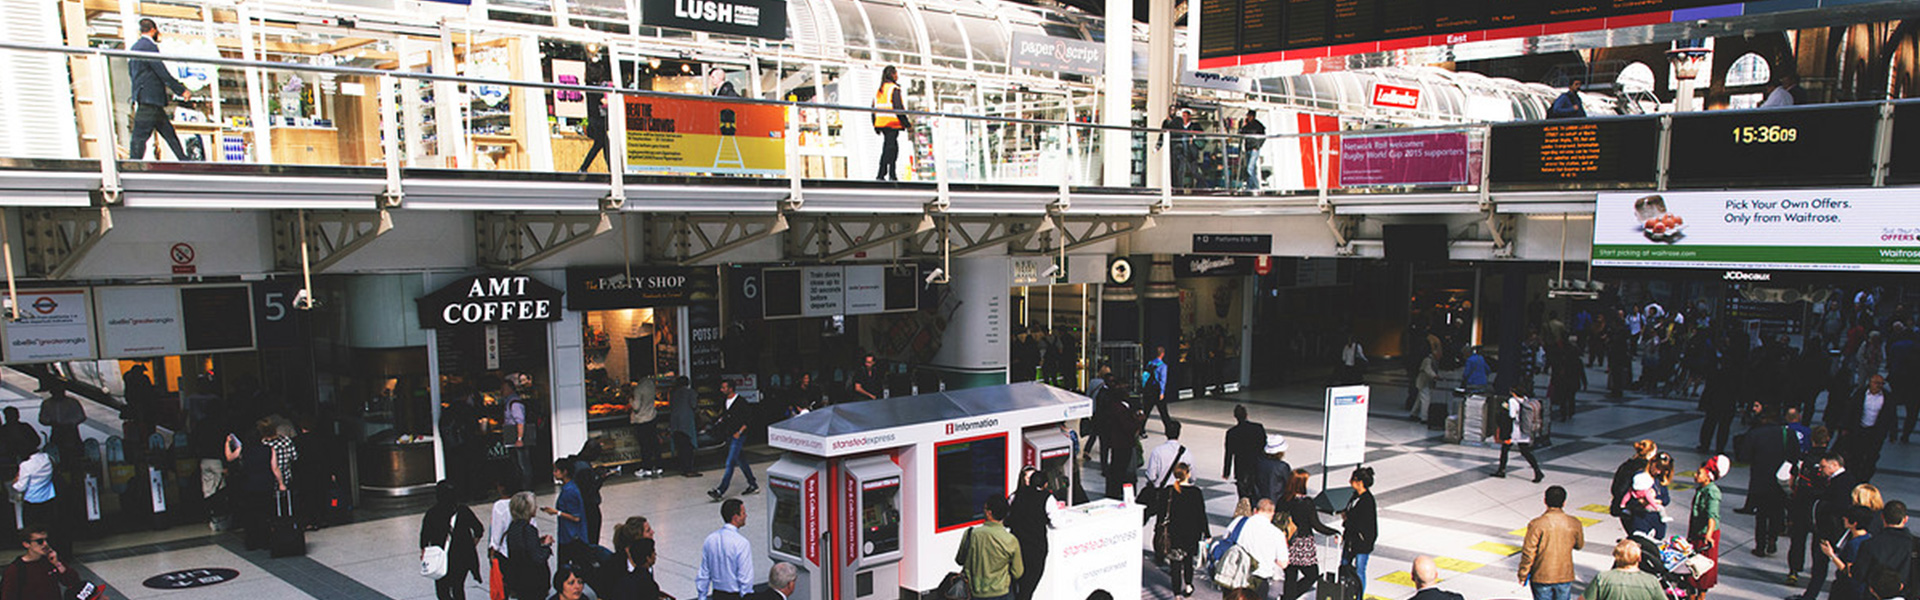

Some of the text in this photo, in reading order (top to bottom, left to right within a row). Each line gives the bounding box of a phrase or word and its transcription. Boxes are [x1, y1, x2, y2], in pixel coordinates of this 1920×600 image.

[675, 0, 733, 23] LUSH
[1446, 34, 1468, 44] East
[1020, 41, 1055, 57] paper
[1066, 46, 1099, 63] script
[1344, 142, 1372, 150] Network
[1389, 140, 1424, 148] welcomes
[1344, 152, 1364, 162] Rugby
[1366, 150, 1388, 158] World
[1388, 150, 1402, 160] Cup
[1726, 198, 1852, 210] Pick Your Own Offers.
[1724, 212, 1841, 226] Only from Waitrose.
[468, 276, 530, 298] AMT
[648, 276, 686, 288] SHOP
[743, 276, 757, 299] 6
[266, 293, 285, 320] 5
[443, 300, 550, 324] COFFEE
[692, 328, 712, 341] POTS
[955, 418, 998, 432] Information
